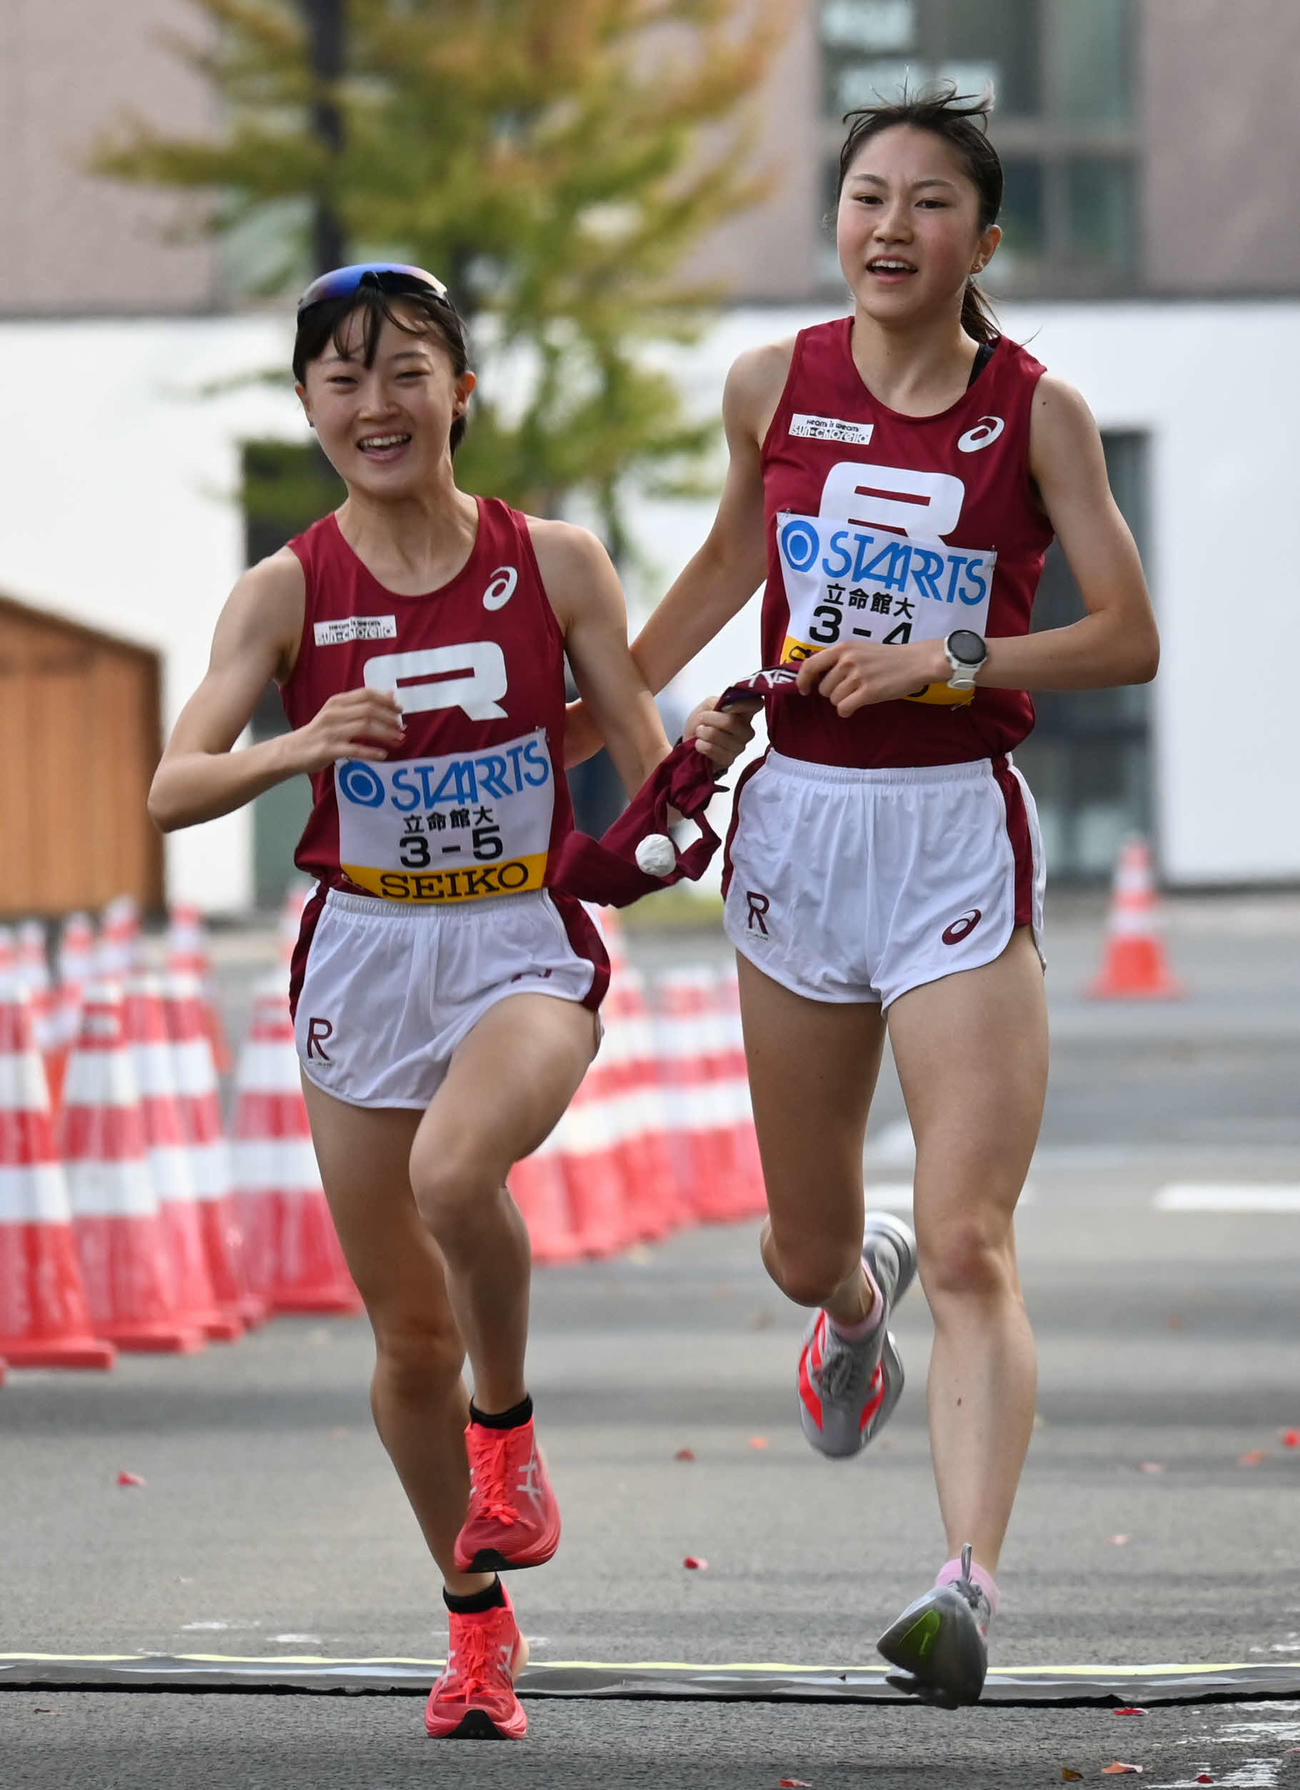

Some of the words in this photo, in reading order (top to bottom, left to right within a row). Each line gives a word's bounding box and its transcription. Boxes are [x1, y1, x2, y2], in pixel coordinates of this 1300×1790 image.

[822, 531, 987, 605] STARTS
[823, 583, 915, 619] 立命館大
[391, 740, 549, 812] STARTS
[403, 805, 494, 834] 立命館大
[380, 862, 529, 899] SEIKO
[307, 1017, 333, 1061] R
